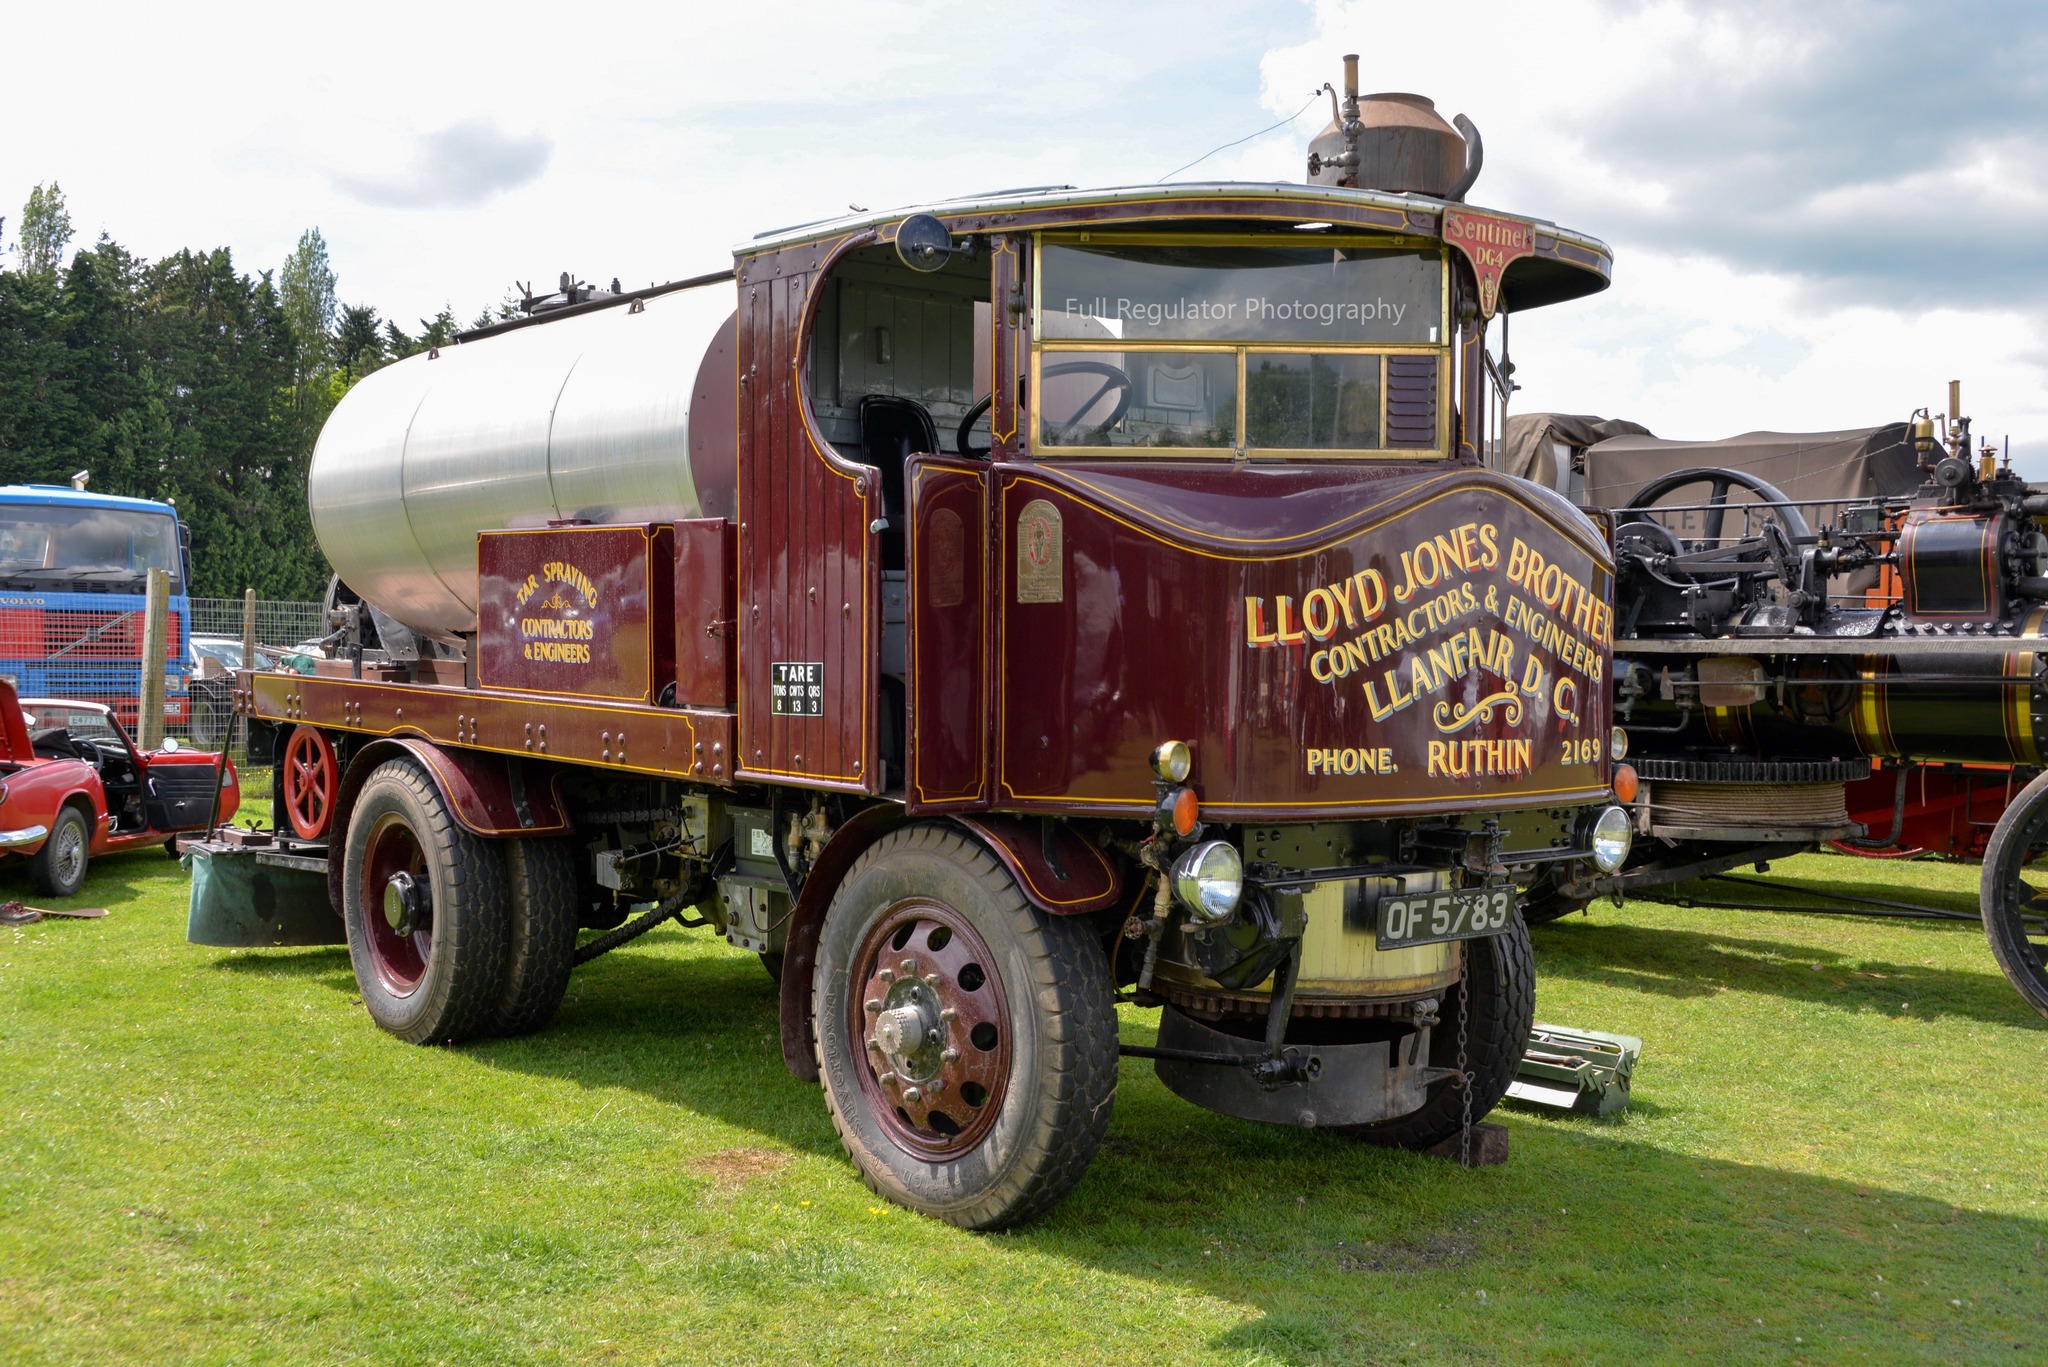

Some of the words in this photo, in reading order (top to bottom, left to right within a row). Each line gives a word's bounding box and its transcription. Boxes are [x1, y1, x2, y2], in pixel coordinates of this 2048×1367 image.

[1450, 213, 1529, 250] Sentinel
[1476, 247, 1504, 267] DG4
[516, 573, 539, 606] TAR
[543, 561, 598, 609] SPRAYING
[1245, 568, 1388, 648] LLOYD
[1393, 522, 1500, 602] JONES
[0, 597, 45, 605] VOLVO
[521, 618, 593, 640] CONTRACTORS
[1484, 585, 1500, 617] &
[1504, 594, 1602, 684] ENGINEERS
[524, 643, 532, 659] &
[533, 641, 590, 663] ENGINEERS
[779, 665, 814, 682] TARE
[1362, 627, 1516, 722] LLANFAIR
[773, 684, 786, 697] TONS
[789, 685, 804, 697] CWTS
[808, 685, 820, 698] QRS
[777, 699, 782, 711] 8
[793, 700, 801, 712] 13
[811, 700, 817, 713] 3
[1428, 739, 1533, 778] RUTHIN
[1561, 738, 1601, 766] 2169
[1386, 900, 1428, 940] OF
[1431, 892, 1509, 936] 5783
